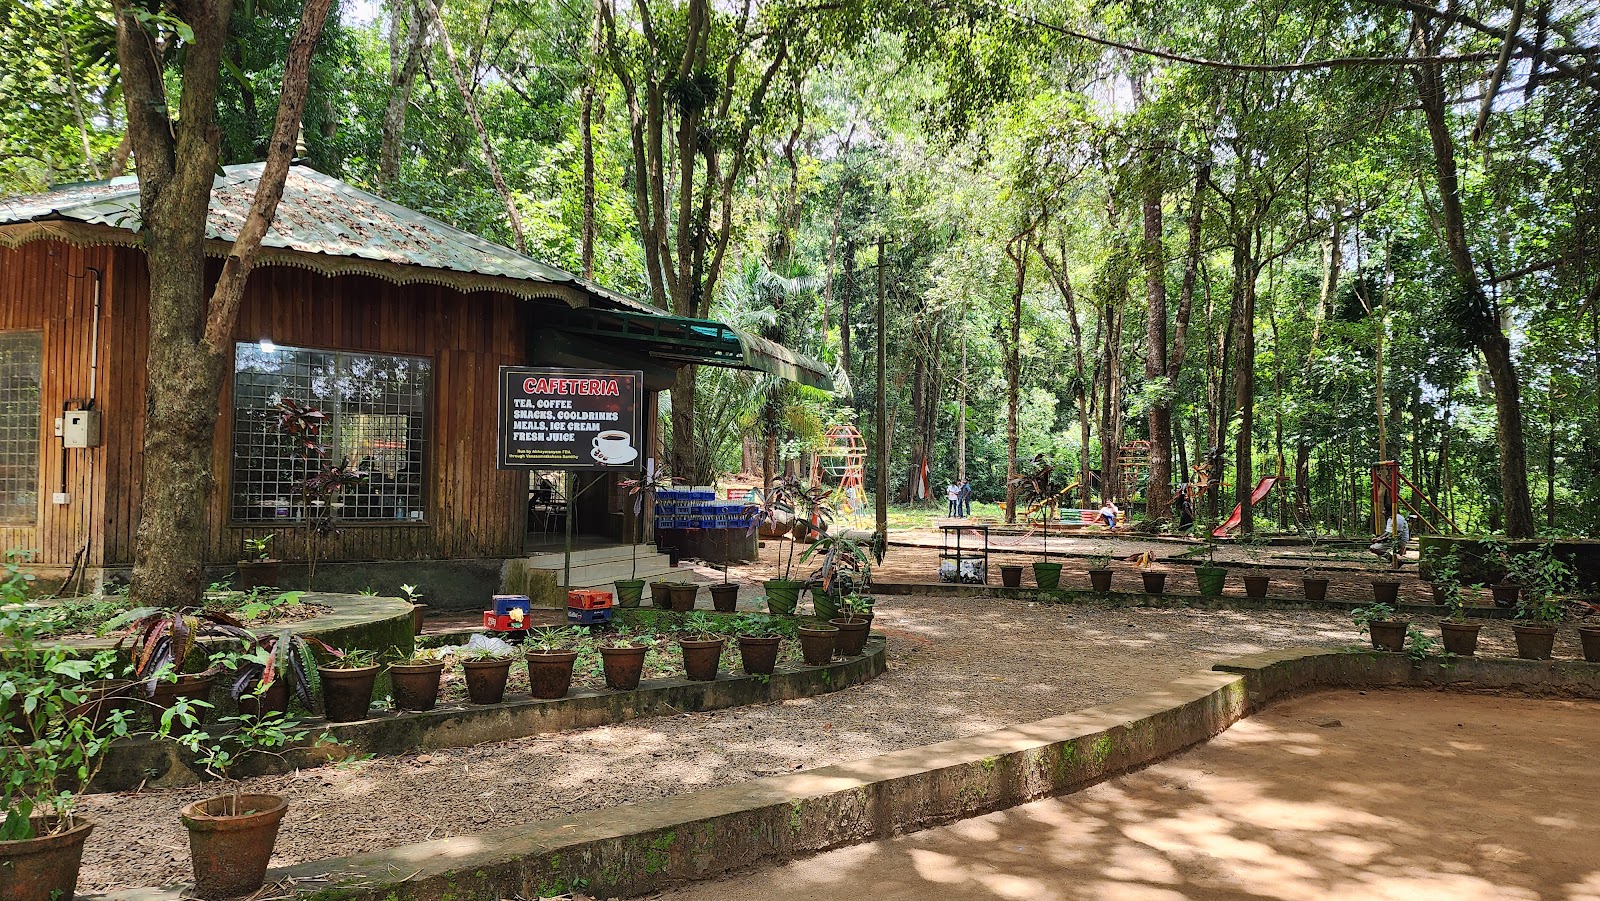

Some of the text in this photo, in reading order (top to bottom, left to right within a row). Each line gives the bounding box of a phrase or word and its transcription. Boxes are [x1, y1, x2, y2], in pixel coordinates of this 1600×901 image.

[523, 377, 619, 396] CAFETERIA
[513, 399, 573, 409] TEA, COFFEE
[513, 410, 619, 421] SNACKS, COOLDRINKS
[513, 421, 600, 432] MEALS, ICE CREAM
[513, 432, 575, 442] FRESH JUICE
